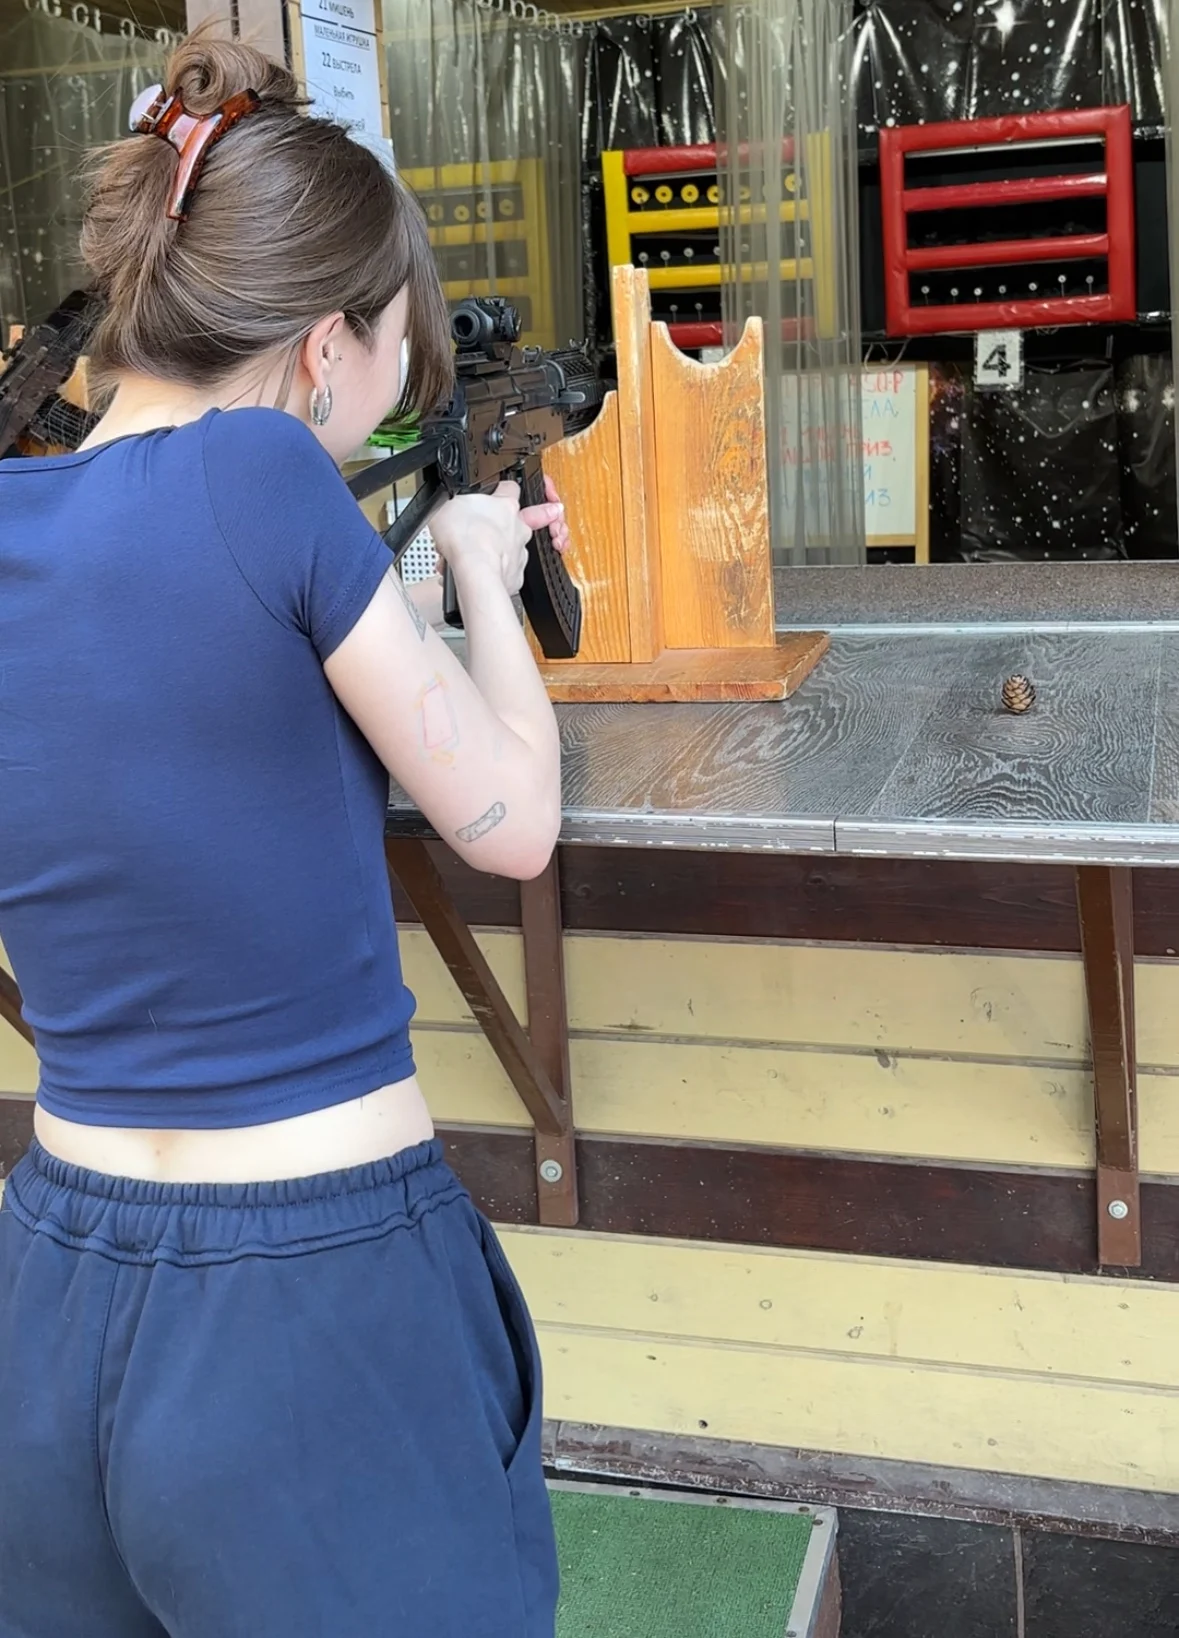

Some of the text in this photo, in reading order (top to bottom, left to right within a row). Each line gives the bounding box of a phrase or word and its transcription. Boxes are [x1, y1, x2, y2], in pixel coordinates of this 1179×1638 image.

[328, 1, 355, 19] МИШЕНЬ
[313, 24, 370, 48] МАЛЕНЬКАЯ ИГРУШКА
[321, 51, 362, 75] 22 ВЫСТРЕЛА
[333, 84, 356, 101] Выбить
[982, 344, 1011, 377] 4
